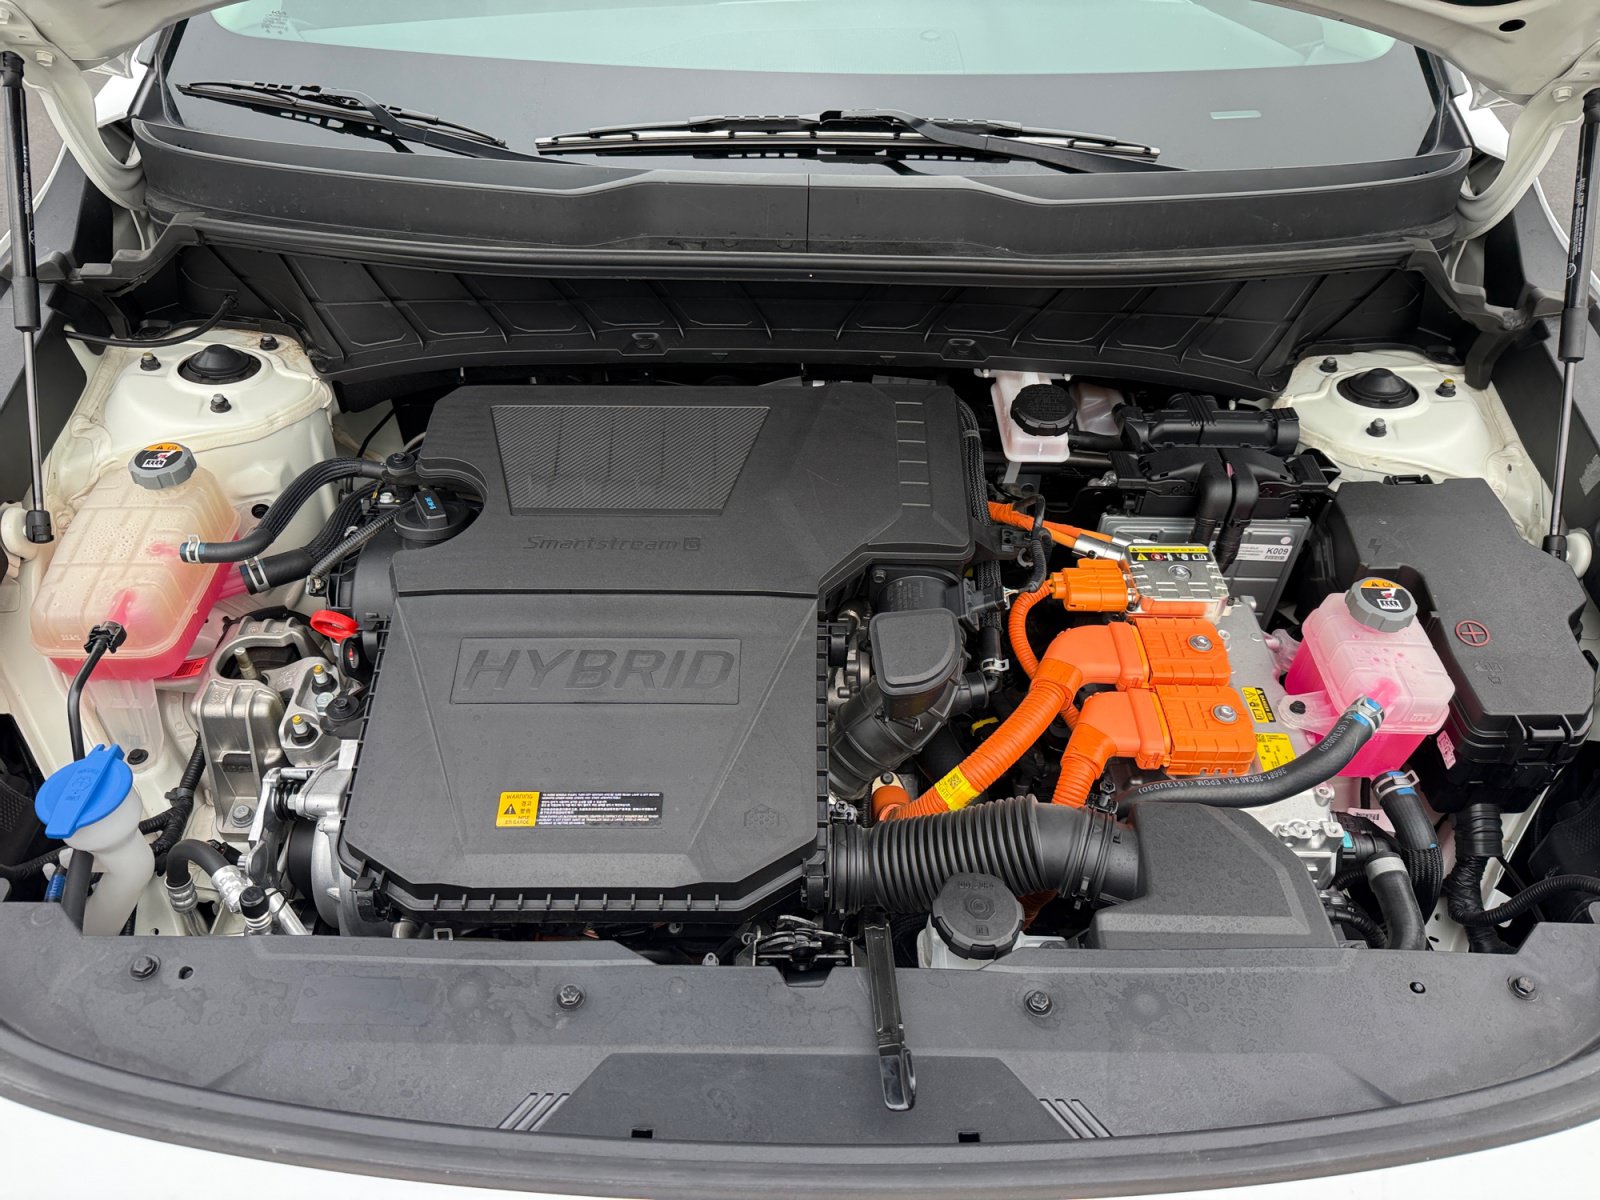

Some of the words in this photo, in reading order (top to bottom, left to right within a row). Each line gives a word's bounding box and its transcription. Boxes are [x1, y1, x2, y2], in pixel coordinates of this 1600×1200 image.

[523, 535, 680, 551] Smartstream
[1266, 547, 1289, 555] K009
[460, 648, 736, 691] HYBRID
[1196, 778, 1221, 787] EPDM
